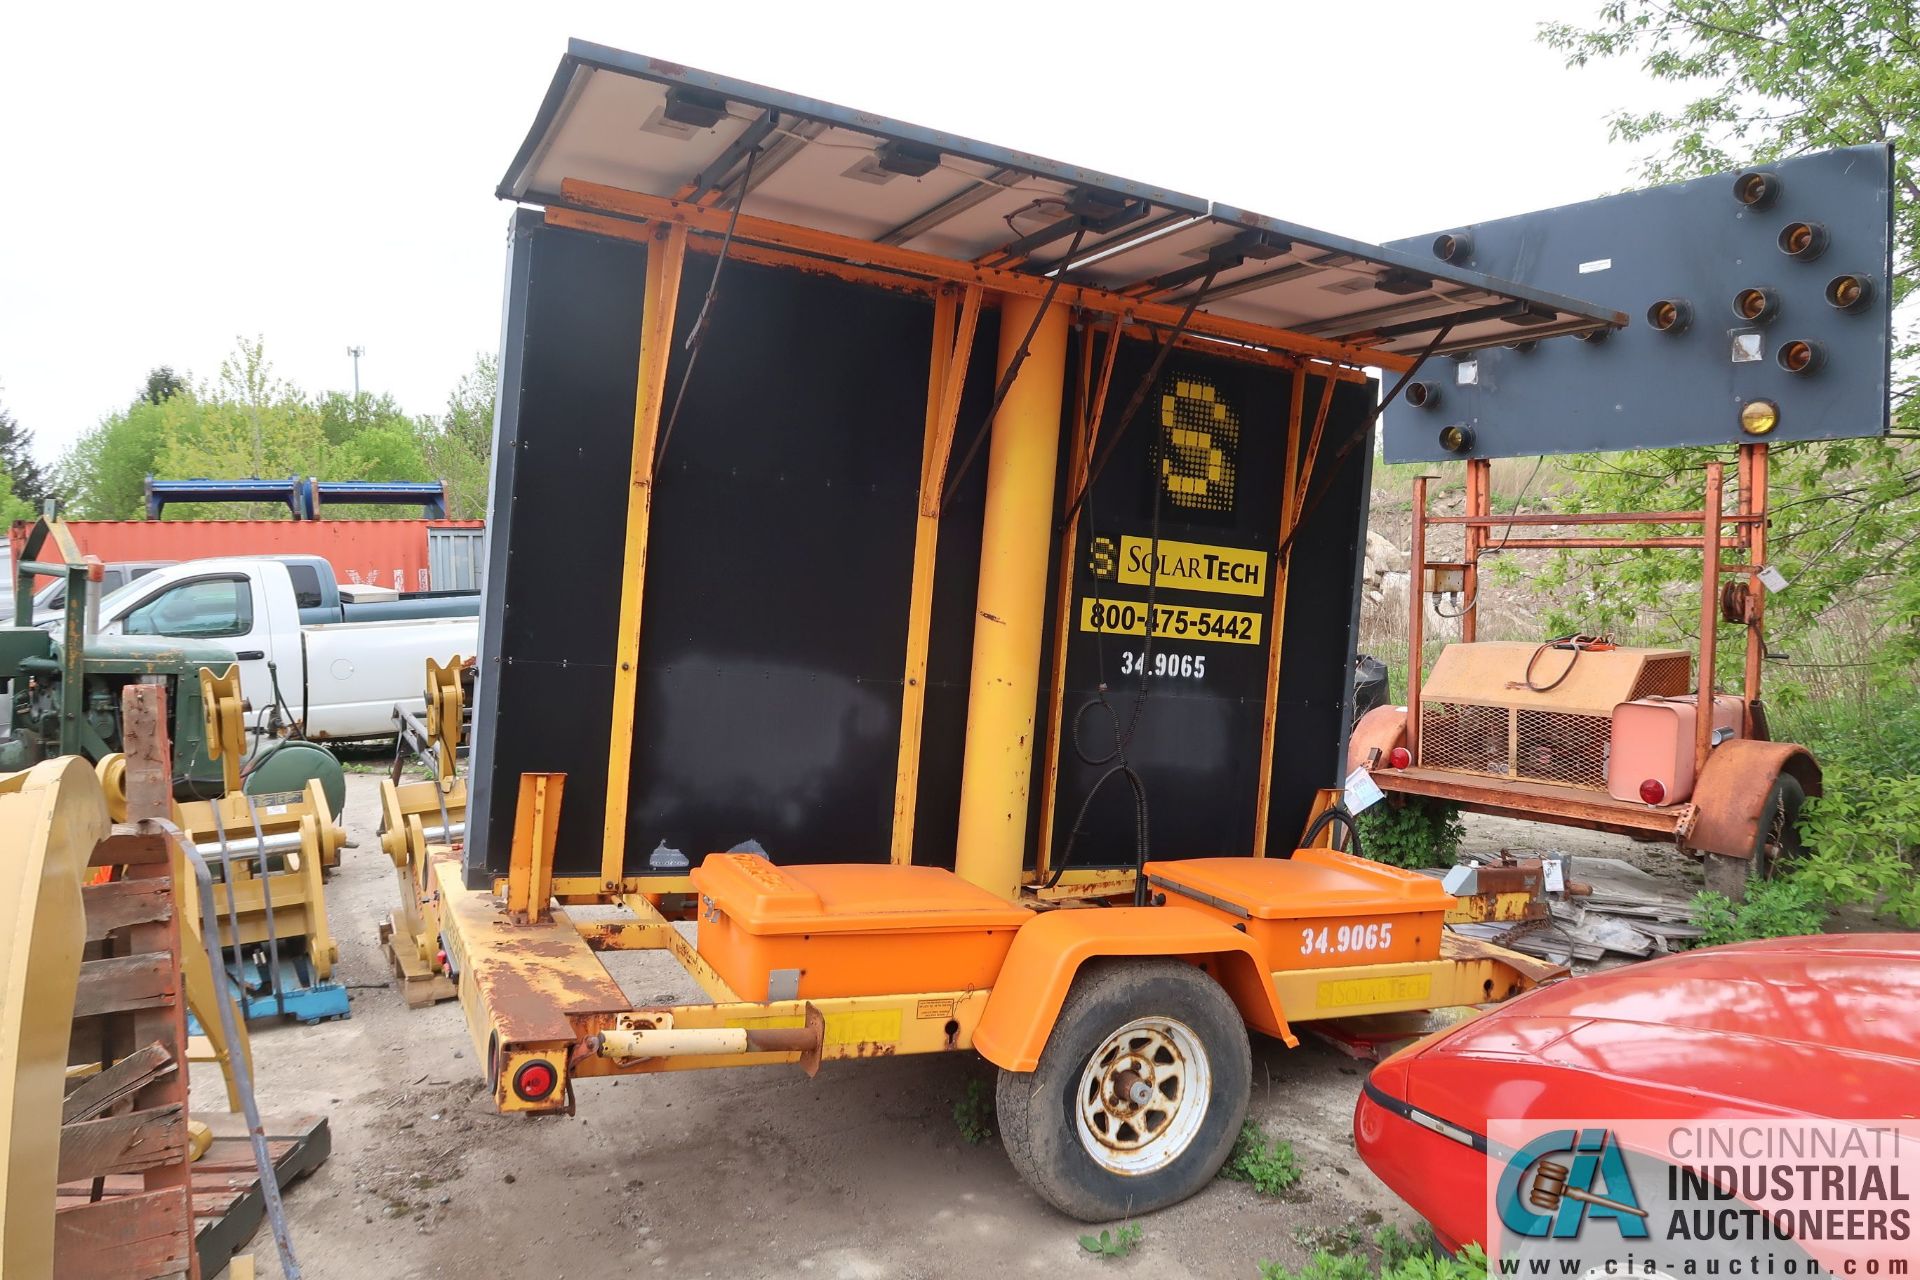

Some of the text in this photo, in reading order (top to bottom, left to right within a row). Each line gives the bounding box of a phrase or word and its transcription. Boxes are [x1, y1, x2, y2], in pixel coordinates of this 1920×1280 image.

[1090, 603, 1253, 640] 800-475-5442
[1121, 651, 1206, 679] 34.9065
[1300, 923, 1392, 955] 34.9065
